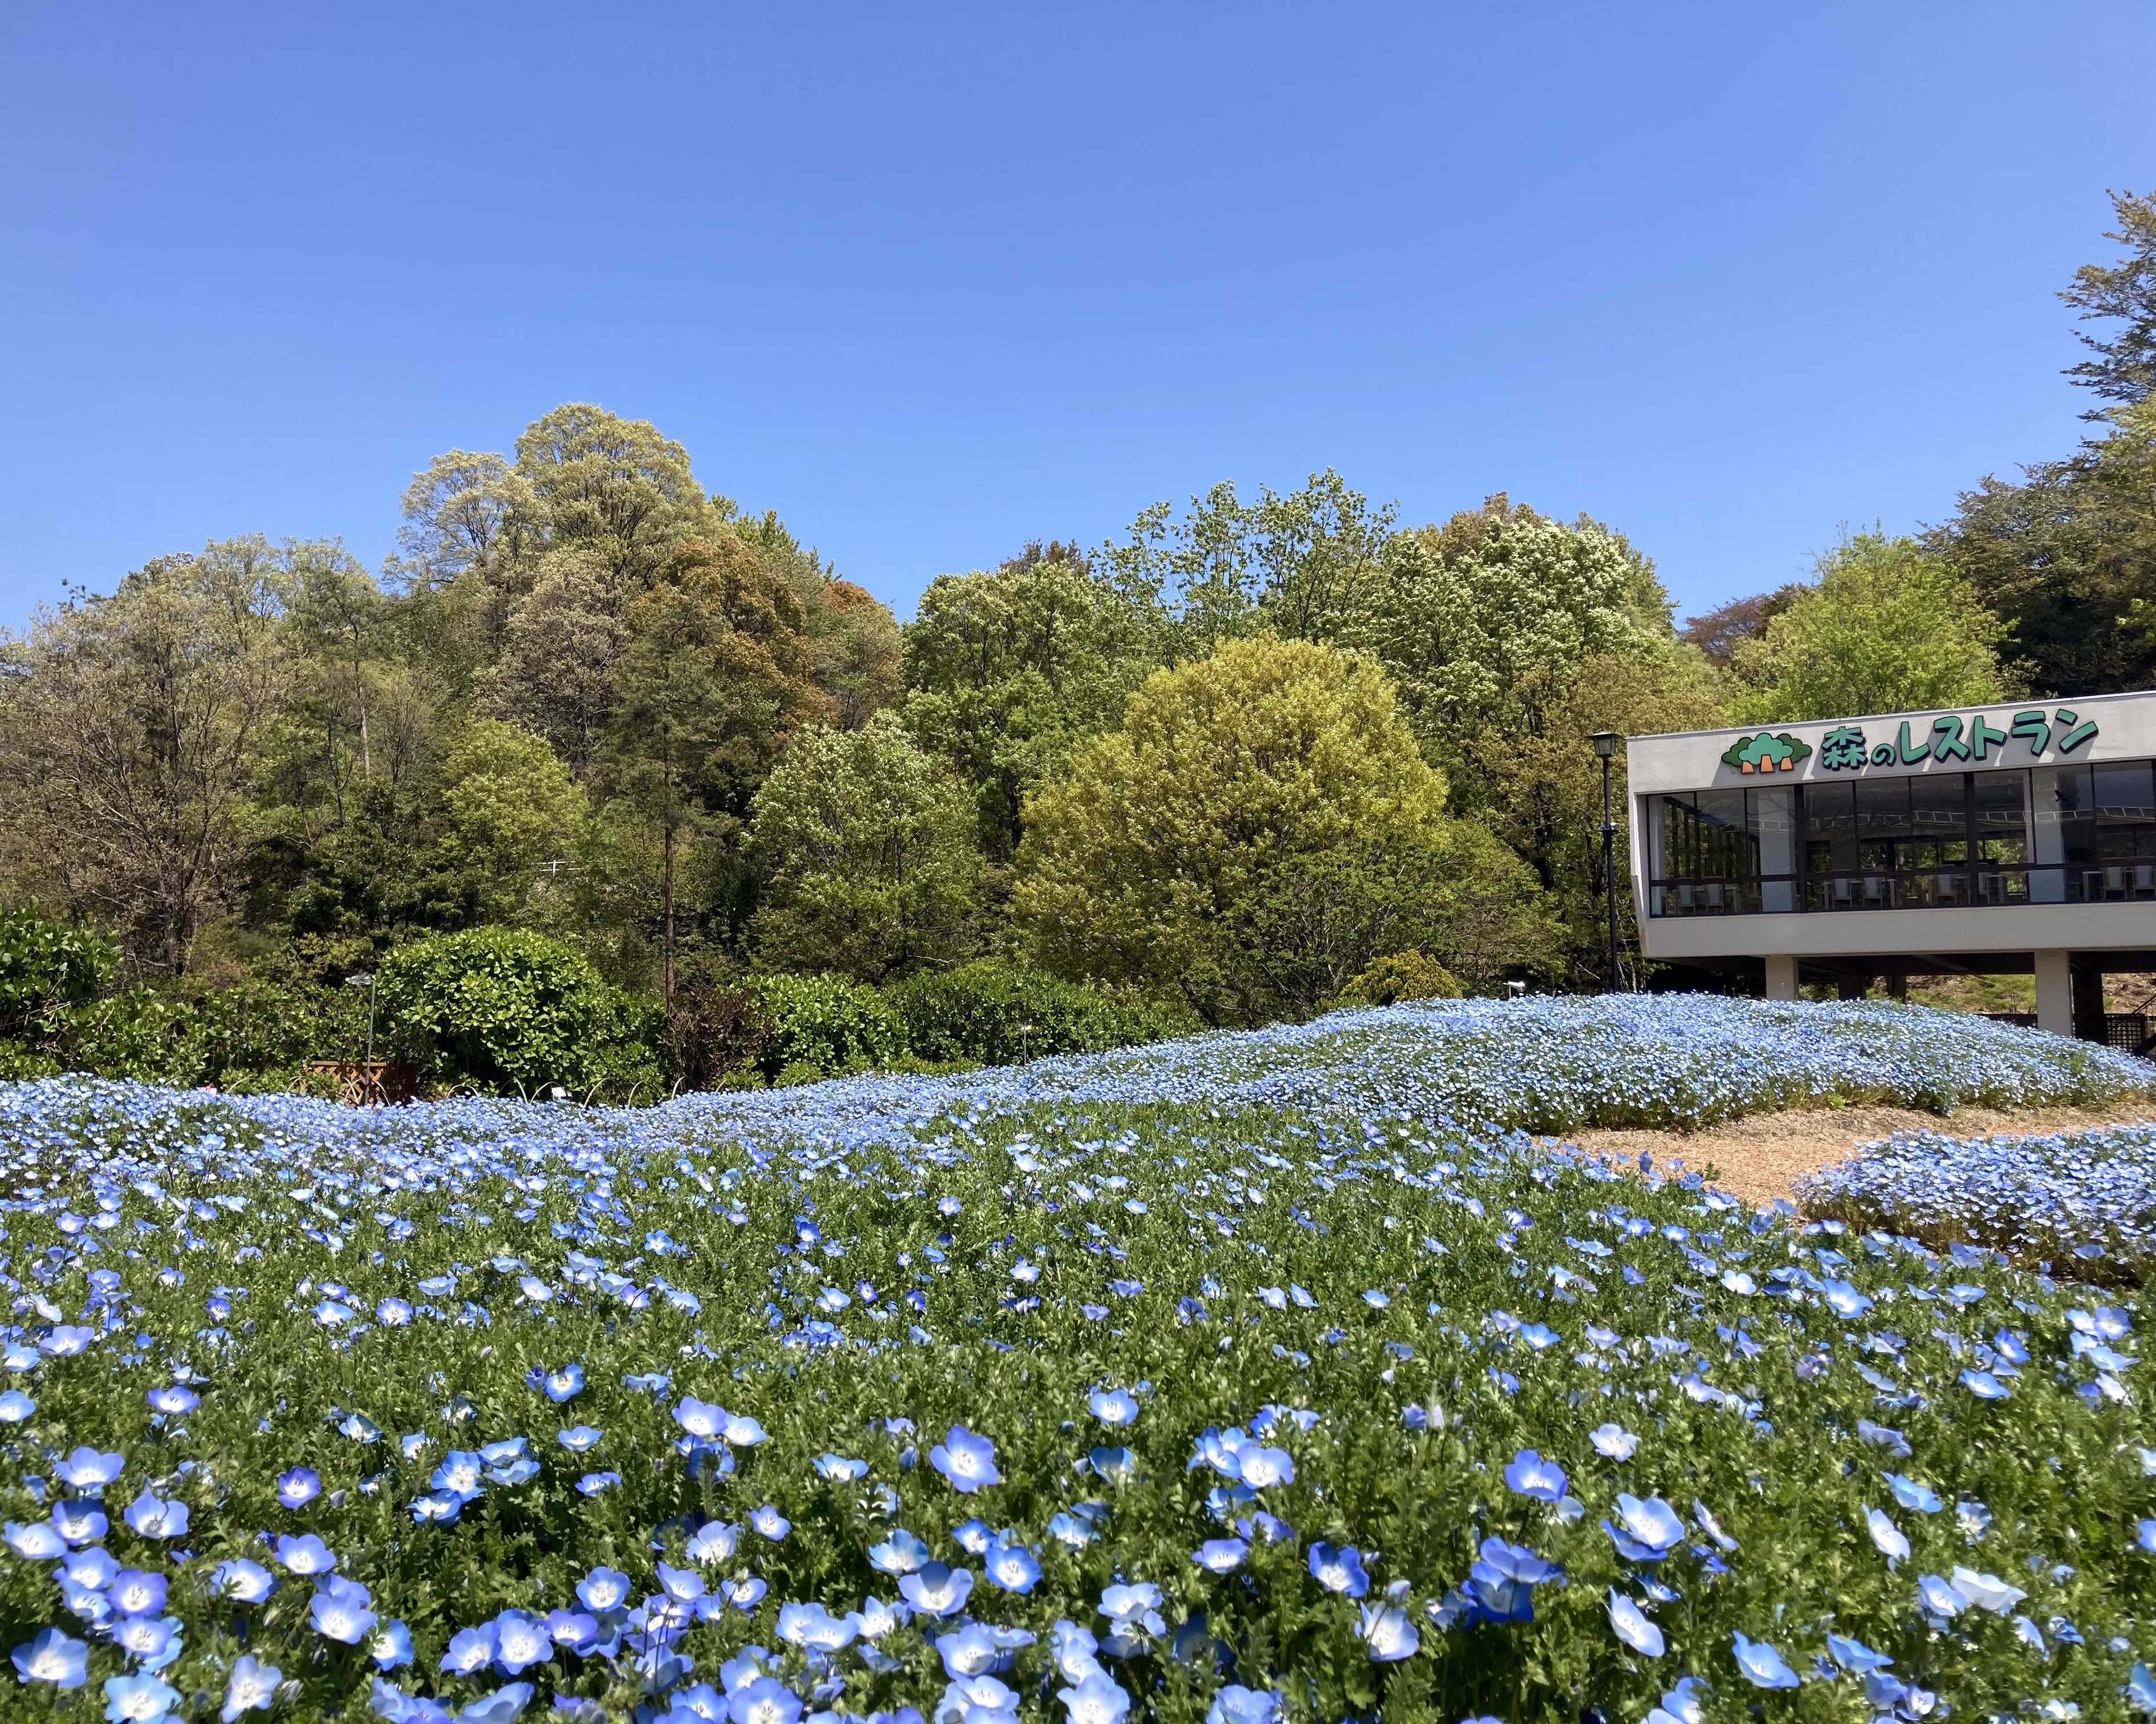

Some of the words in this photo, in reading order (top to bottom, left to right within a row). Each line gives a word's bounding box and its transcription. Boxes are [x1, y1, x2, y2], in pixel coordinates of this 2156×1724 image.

[1822, 709, 2098, 771] 森のレストラン
